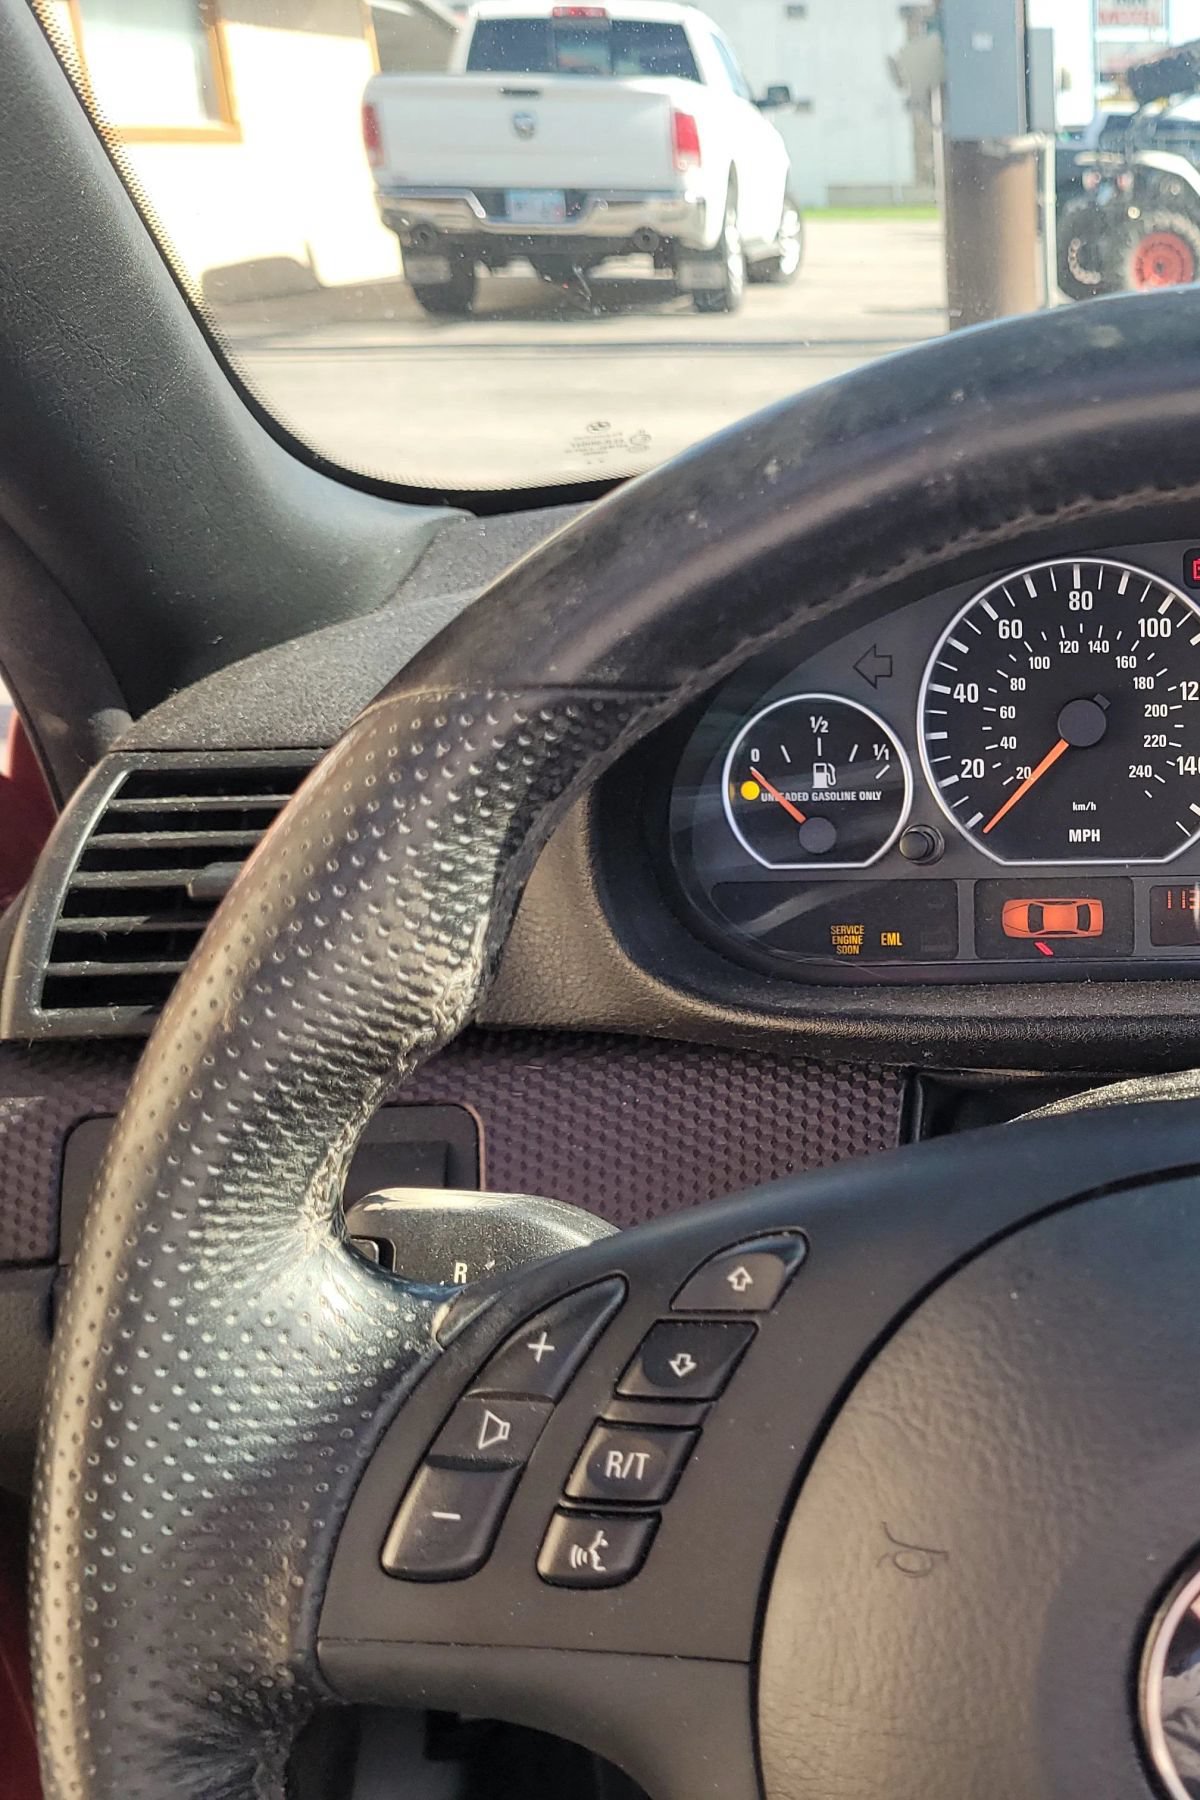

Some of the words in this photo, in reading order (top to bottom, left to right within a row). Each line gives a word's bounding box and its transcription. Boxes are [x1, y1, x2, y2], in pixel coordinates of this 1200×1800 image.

[1068, 590, 1093, 611] 80
[998, 619, 1023, 639] 60
[1138, 617, 1172, 638] 100
[1058, 640, 1079, 654] 120
[1087, 640, 1110, 654] 140
[1028, 656, 1050, 670] 100
[1115, 655, 1137, 669] 160
[1009, 678, 1026, 691] 80
[1133, 677, 1155, 690] 180
[953, 683, 979, 703] 40
[999, 705, 1016, 719] 60
[1144, 704, 1168, 718] 200
[1000, 736, 1017, 749] 40
[1143, 735, 1167, 748] 220
[750, 748, 760, 763] 0
[960, 758, 985, 779] 20
[1016, 766, 1032, 780] 20
[1128, 765, 1152, 778] 240
[812, 791, 857, 801] GASOLINE
[859, 791, 882, 801] ONLY
[1072, 801, 1097, 811] km/h
[1068, 829, 1101, 842] MPH
[830, 925, 865, 935] SERVICE
[831, 935, 864, 945] ENGINE
[881, 932, 903, 946] EML
[836, 945, 860, 955] SOON
[453, 1261, 468, 1284] R
[604, 1449, 651, 1481] R/T
